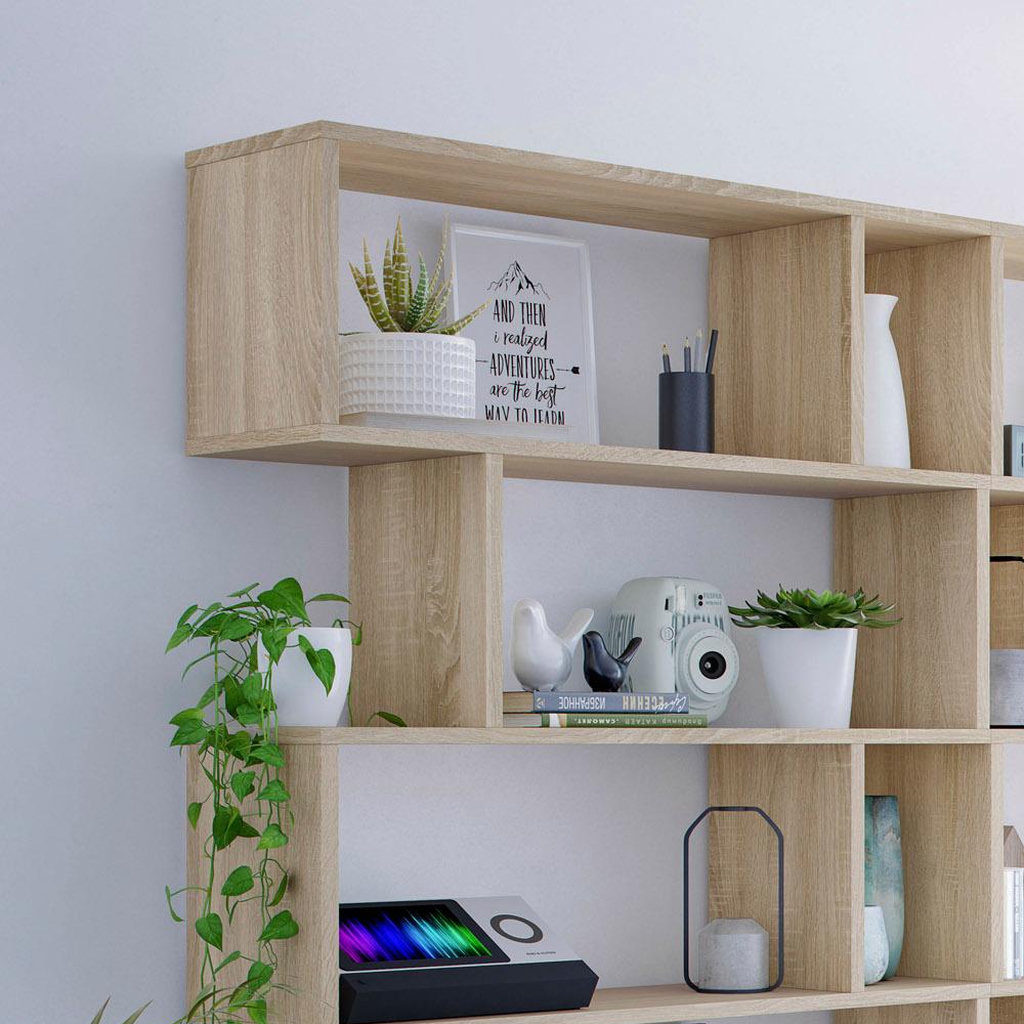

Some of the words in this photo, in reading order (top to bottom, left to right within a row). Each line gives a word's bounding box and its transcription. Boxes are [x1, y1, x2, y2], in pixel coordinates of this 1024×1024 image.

[493, 299, 514, 324] AND
[519, 301, 546, 326] THEN
[494, 332, 500, 344] i
[504, 327, 548, 354] realized
[490, 353, 556, 380] ADVENTURES
[490, 385, 509, 398] are
[510, 380, 531, 402] the
[535, 380, 566, 408] best
[558, 696, 606, 709] ИЗБРАННОЕ
